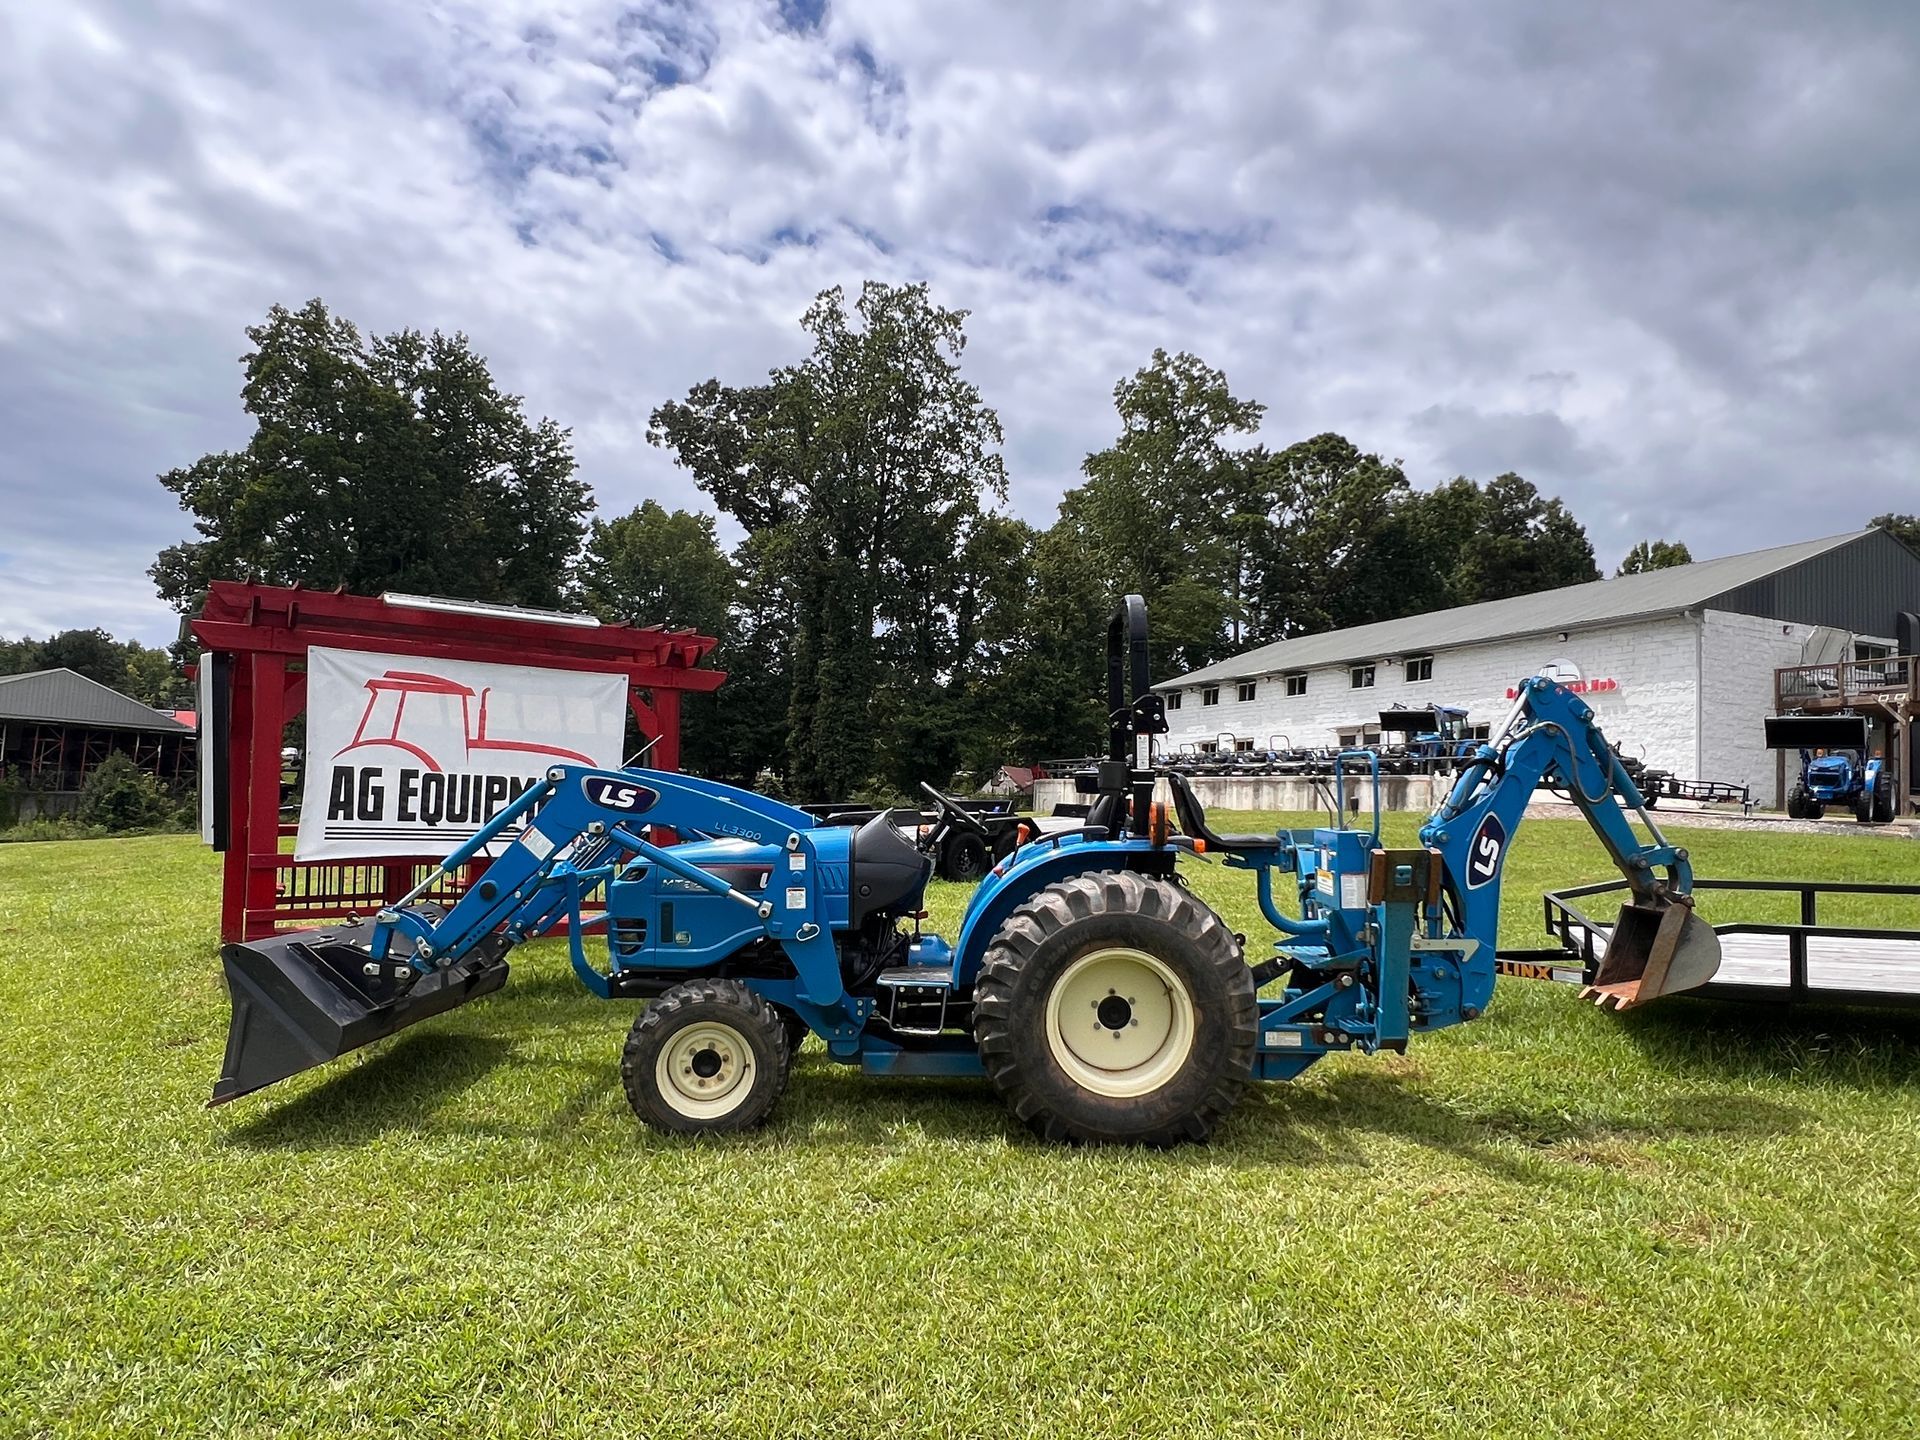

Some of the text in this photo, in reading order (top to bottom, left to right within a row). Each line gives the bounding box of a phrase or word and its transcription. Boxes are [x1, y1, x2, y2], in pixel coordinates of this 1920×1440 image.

[327, 765, 553, 826] AG EQUIPM
[599, 784, 638, 809] LS
[714, 821, 762, 841] LL3300
[1473, 835, 1500, 877] LS
